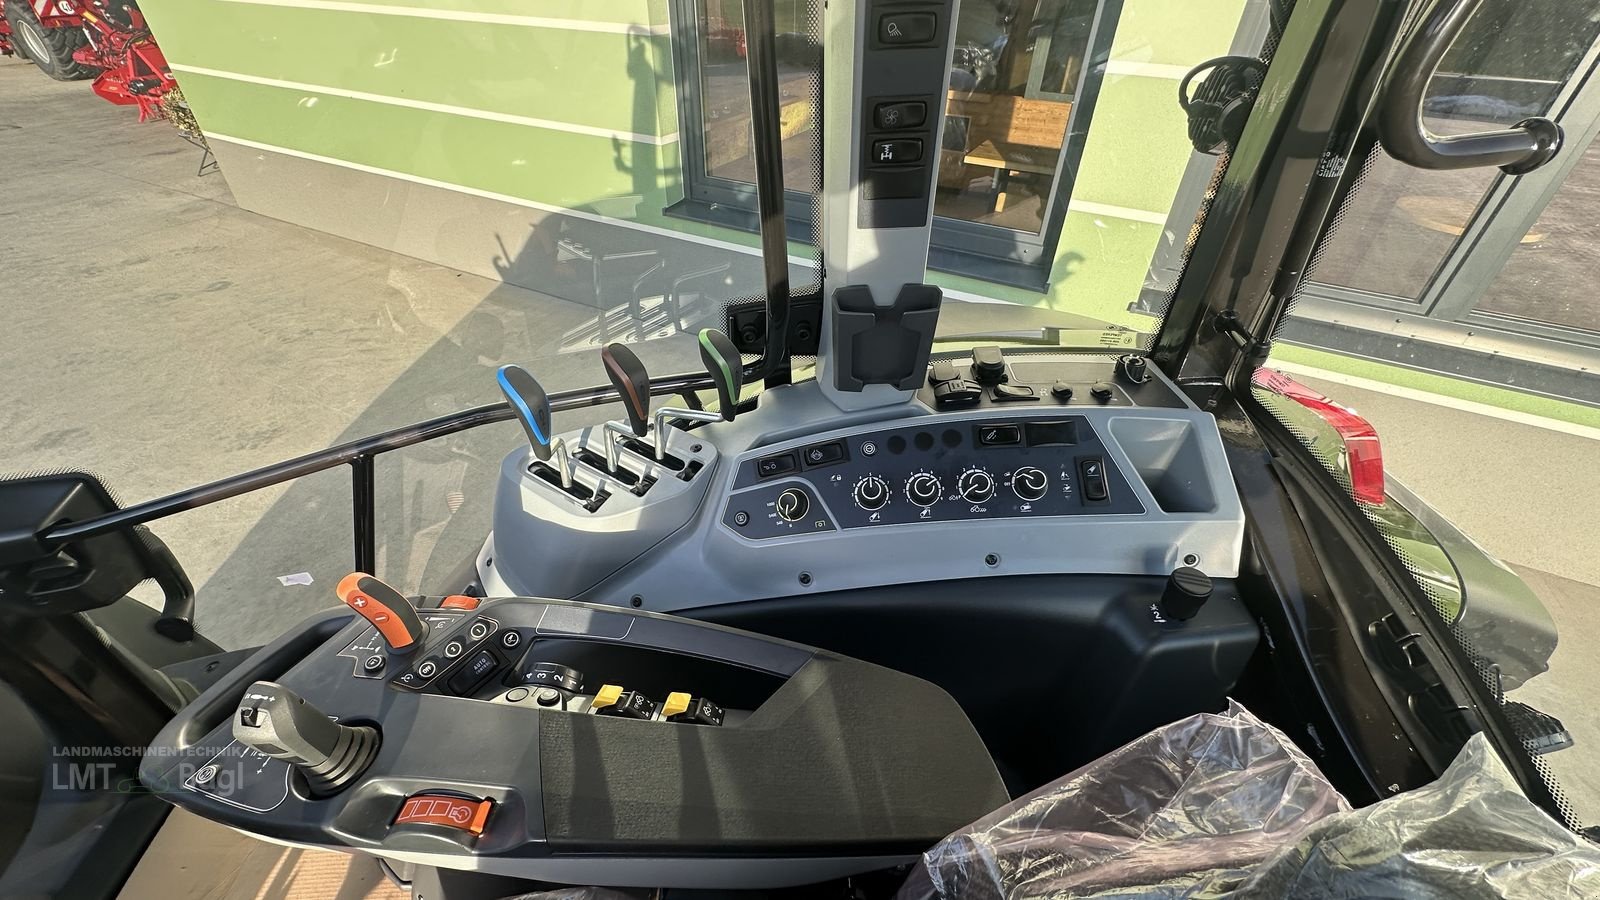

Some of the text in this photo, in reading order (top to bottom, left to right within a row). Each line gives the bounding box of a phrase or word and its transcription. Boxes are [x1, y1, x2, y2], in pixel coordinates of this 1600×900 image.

[422, 664, 432, 674] OFF
[473, 658, 487, 670] AUTO
[553, 674, 564, 682] 2
